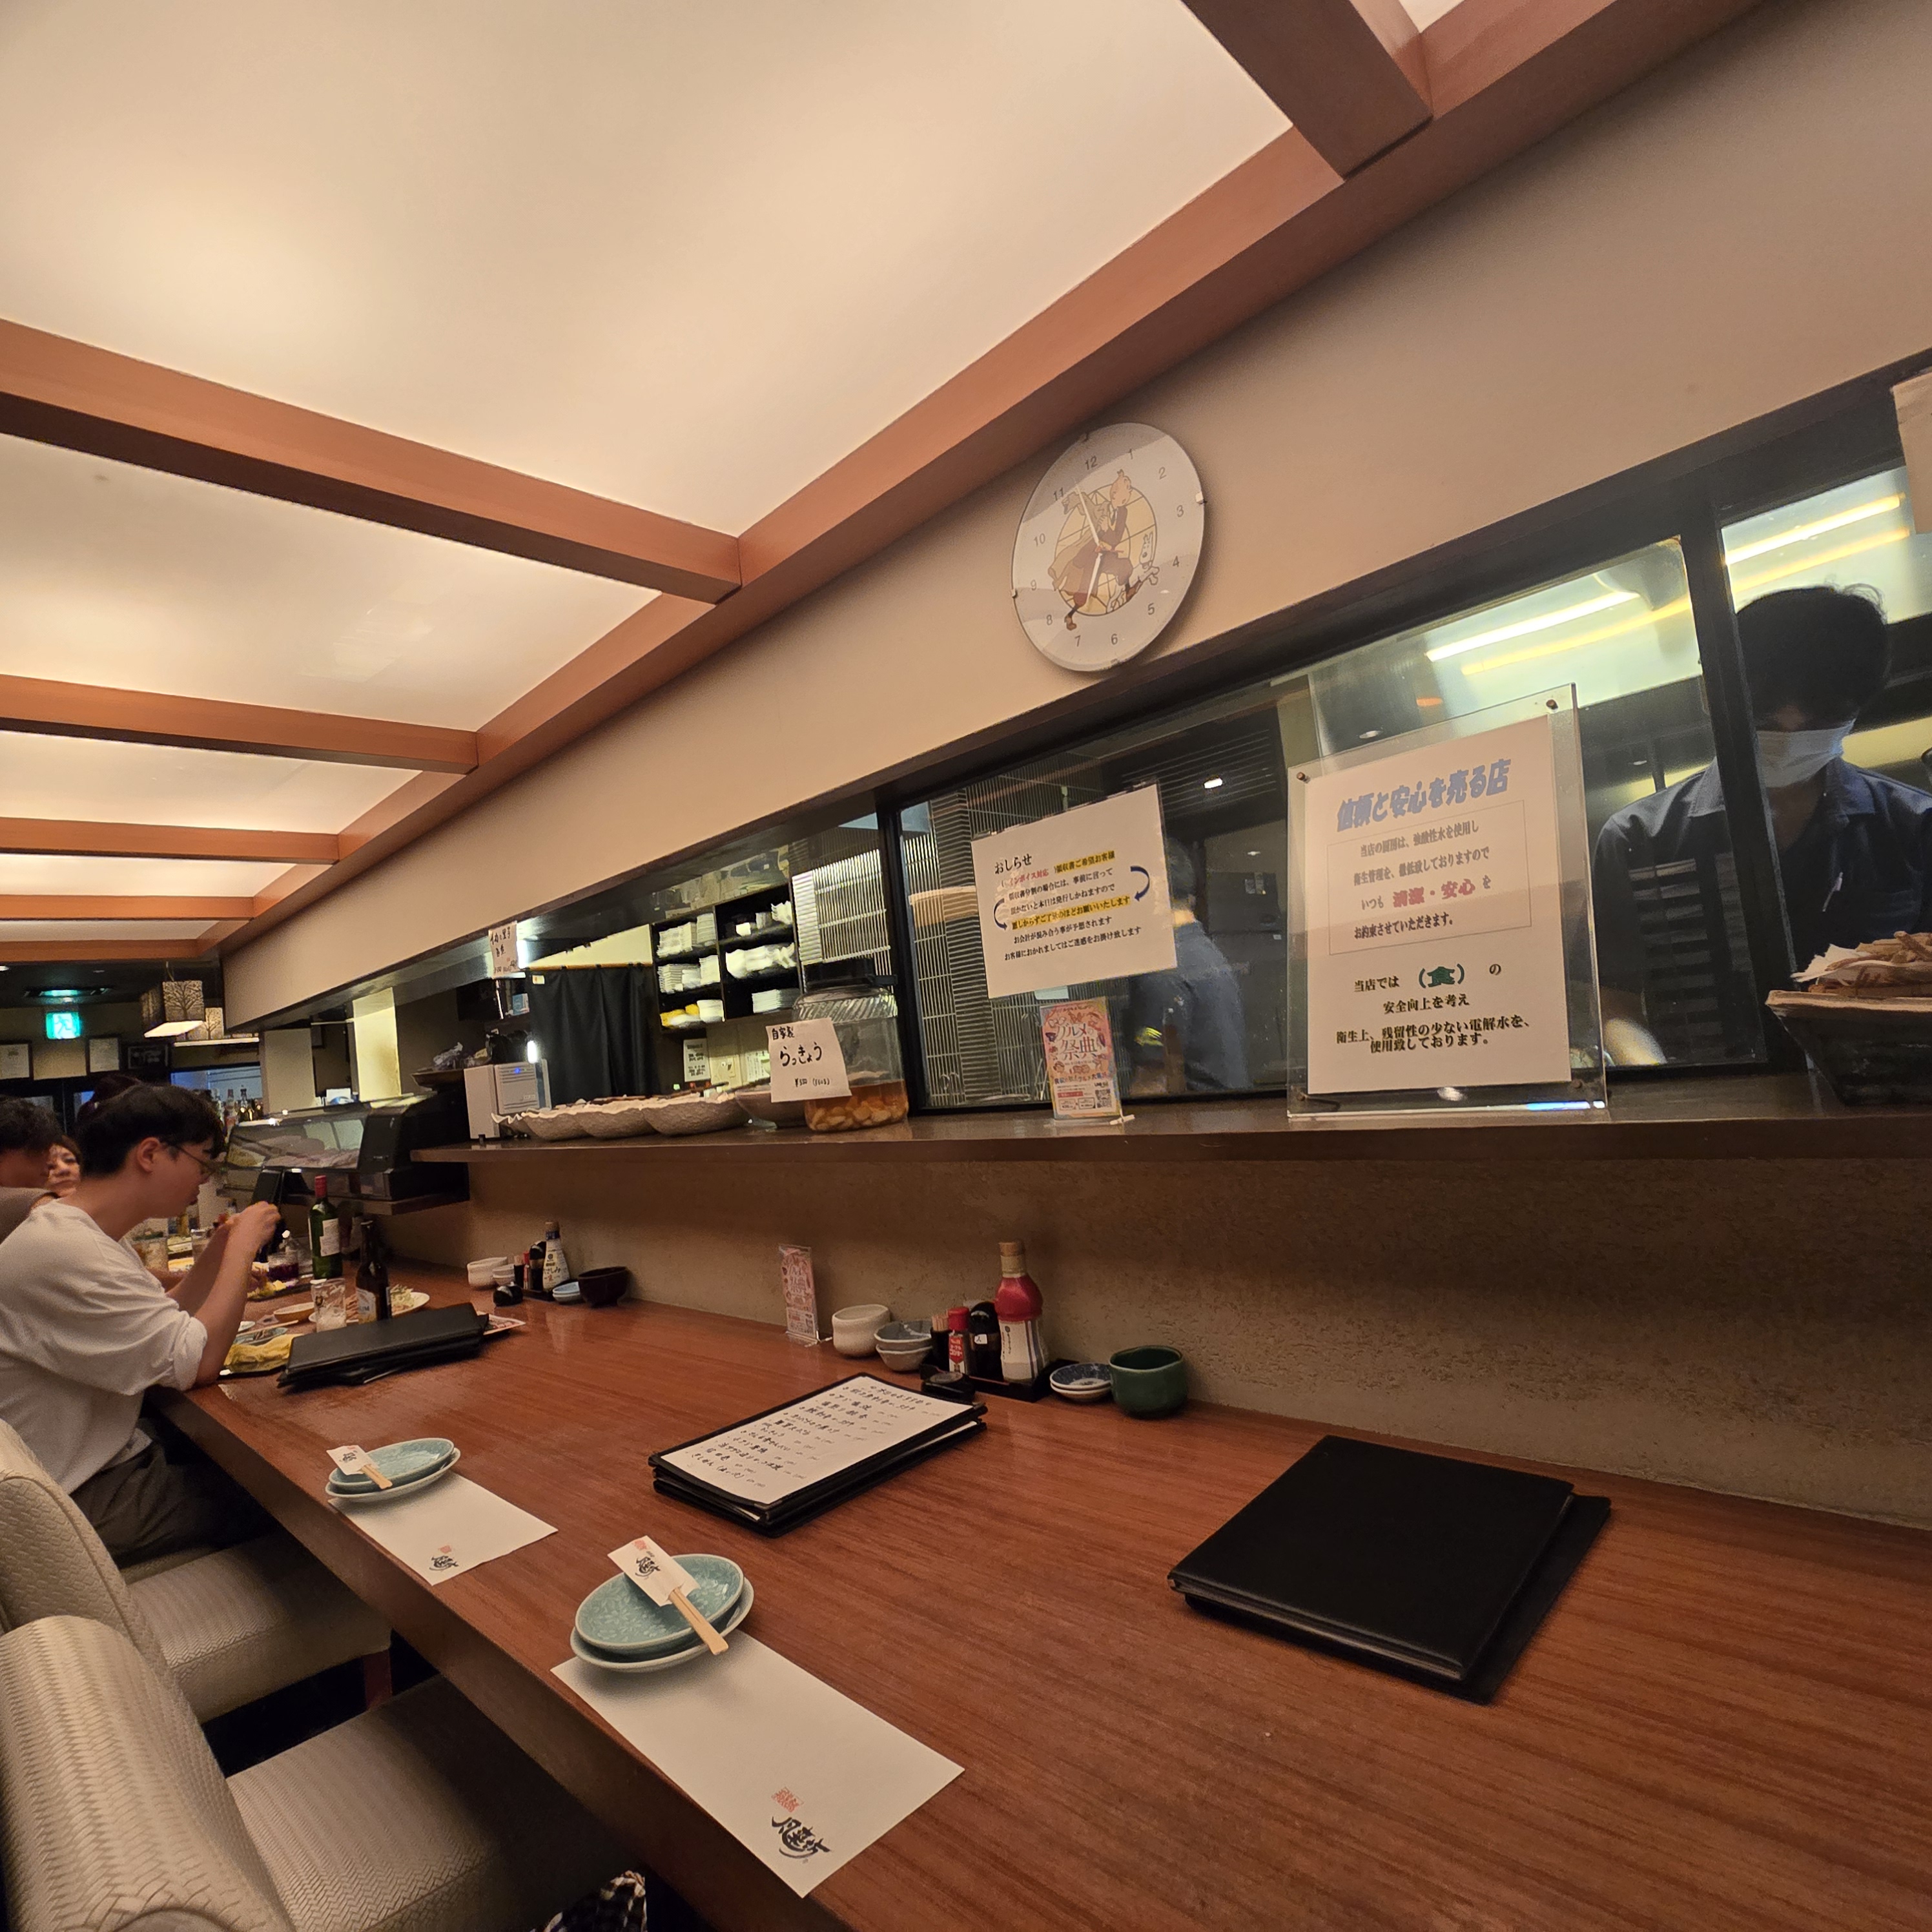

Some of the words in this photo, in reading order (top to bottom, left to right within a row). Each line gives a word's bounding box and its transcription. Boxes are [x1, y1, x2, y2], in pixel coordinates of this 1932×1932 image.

[1128, 448, 1133, 460] 1
[1085, 455, 1098, 469] 12
[1158, 467, 1166, 479] 2
[1053, 488, 1064, 502] 11
[1176, 504, 1184, 517] 3
[1034, 533, 1046, 546] 10
[1172, 555, 1180, 568] 4
[1031, 580, 1037, 591] 9
[1147, 603, 1155, 615] 5
[1046, 614, 1053, 625] 8
[1074, 635, 1082, 647] 7
[1111, 633, 1118, 645] 6
[1337, 759, 1512, 832] 信頼と安心を売る店
[994, 854, 1033, 875] おしらせ
[1361, 896, 1384, 910] いつも
[1392, 878, 1476, 908] 清潔・安心
[1482, 874, 1491, 889] を
[1353, 911, 1454, 940] お約束させていただきます。
[1353, 976, 1400, 992] 当店では
[1489, 963, 1501, 976] の
[1383, 993, 1470, 1014] 安全向上を考え
[772, 1025, 795, 1041] 自家製
[1336, 1014, 1530, 1044] 衛生上、残留性の少ない電解水を、
[1060, 1036, 1098, 1061] 祭典
[1370, 1032, 1489, 1054] 使用致しております。
[779, 1042, 823, 1067] らっきょう
